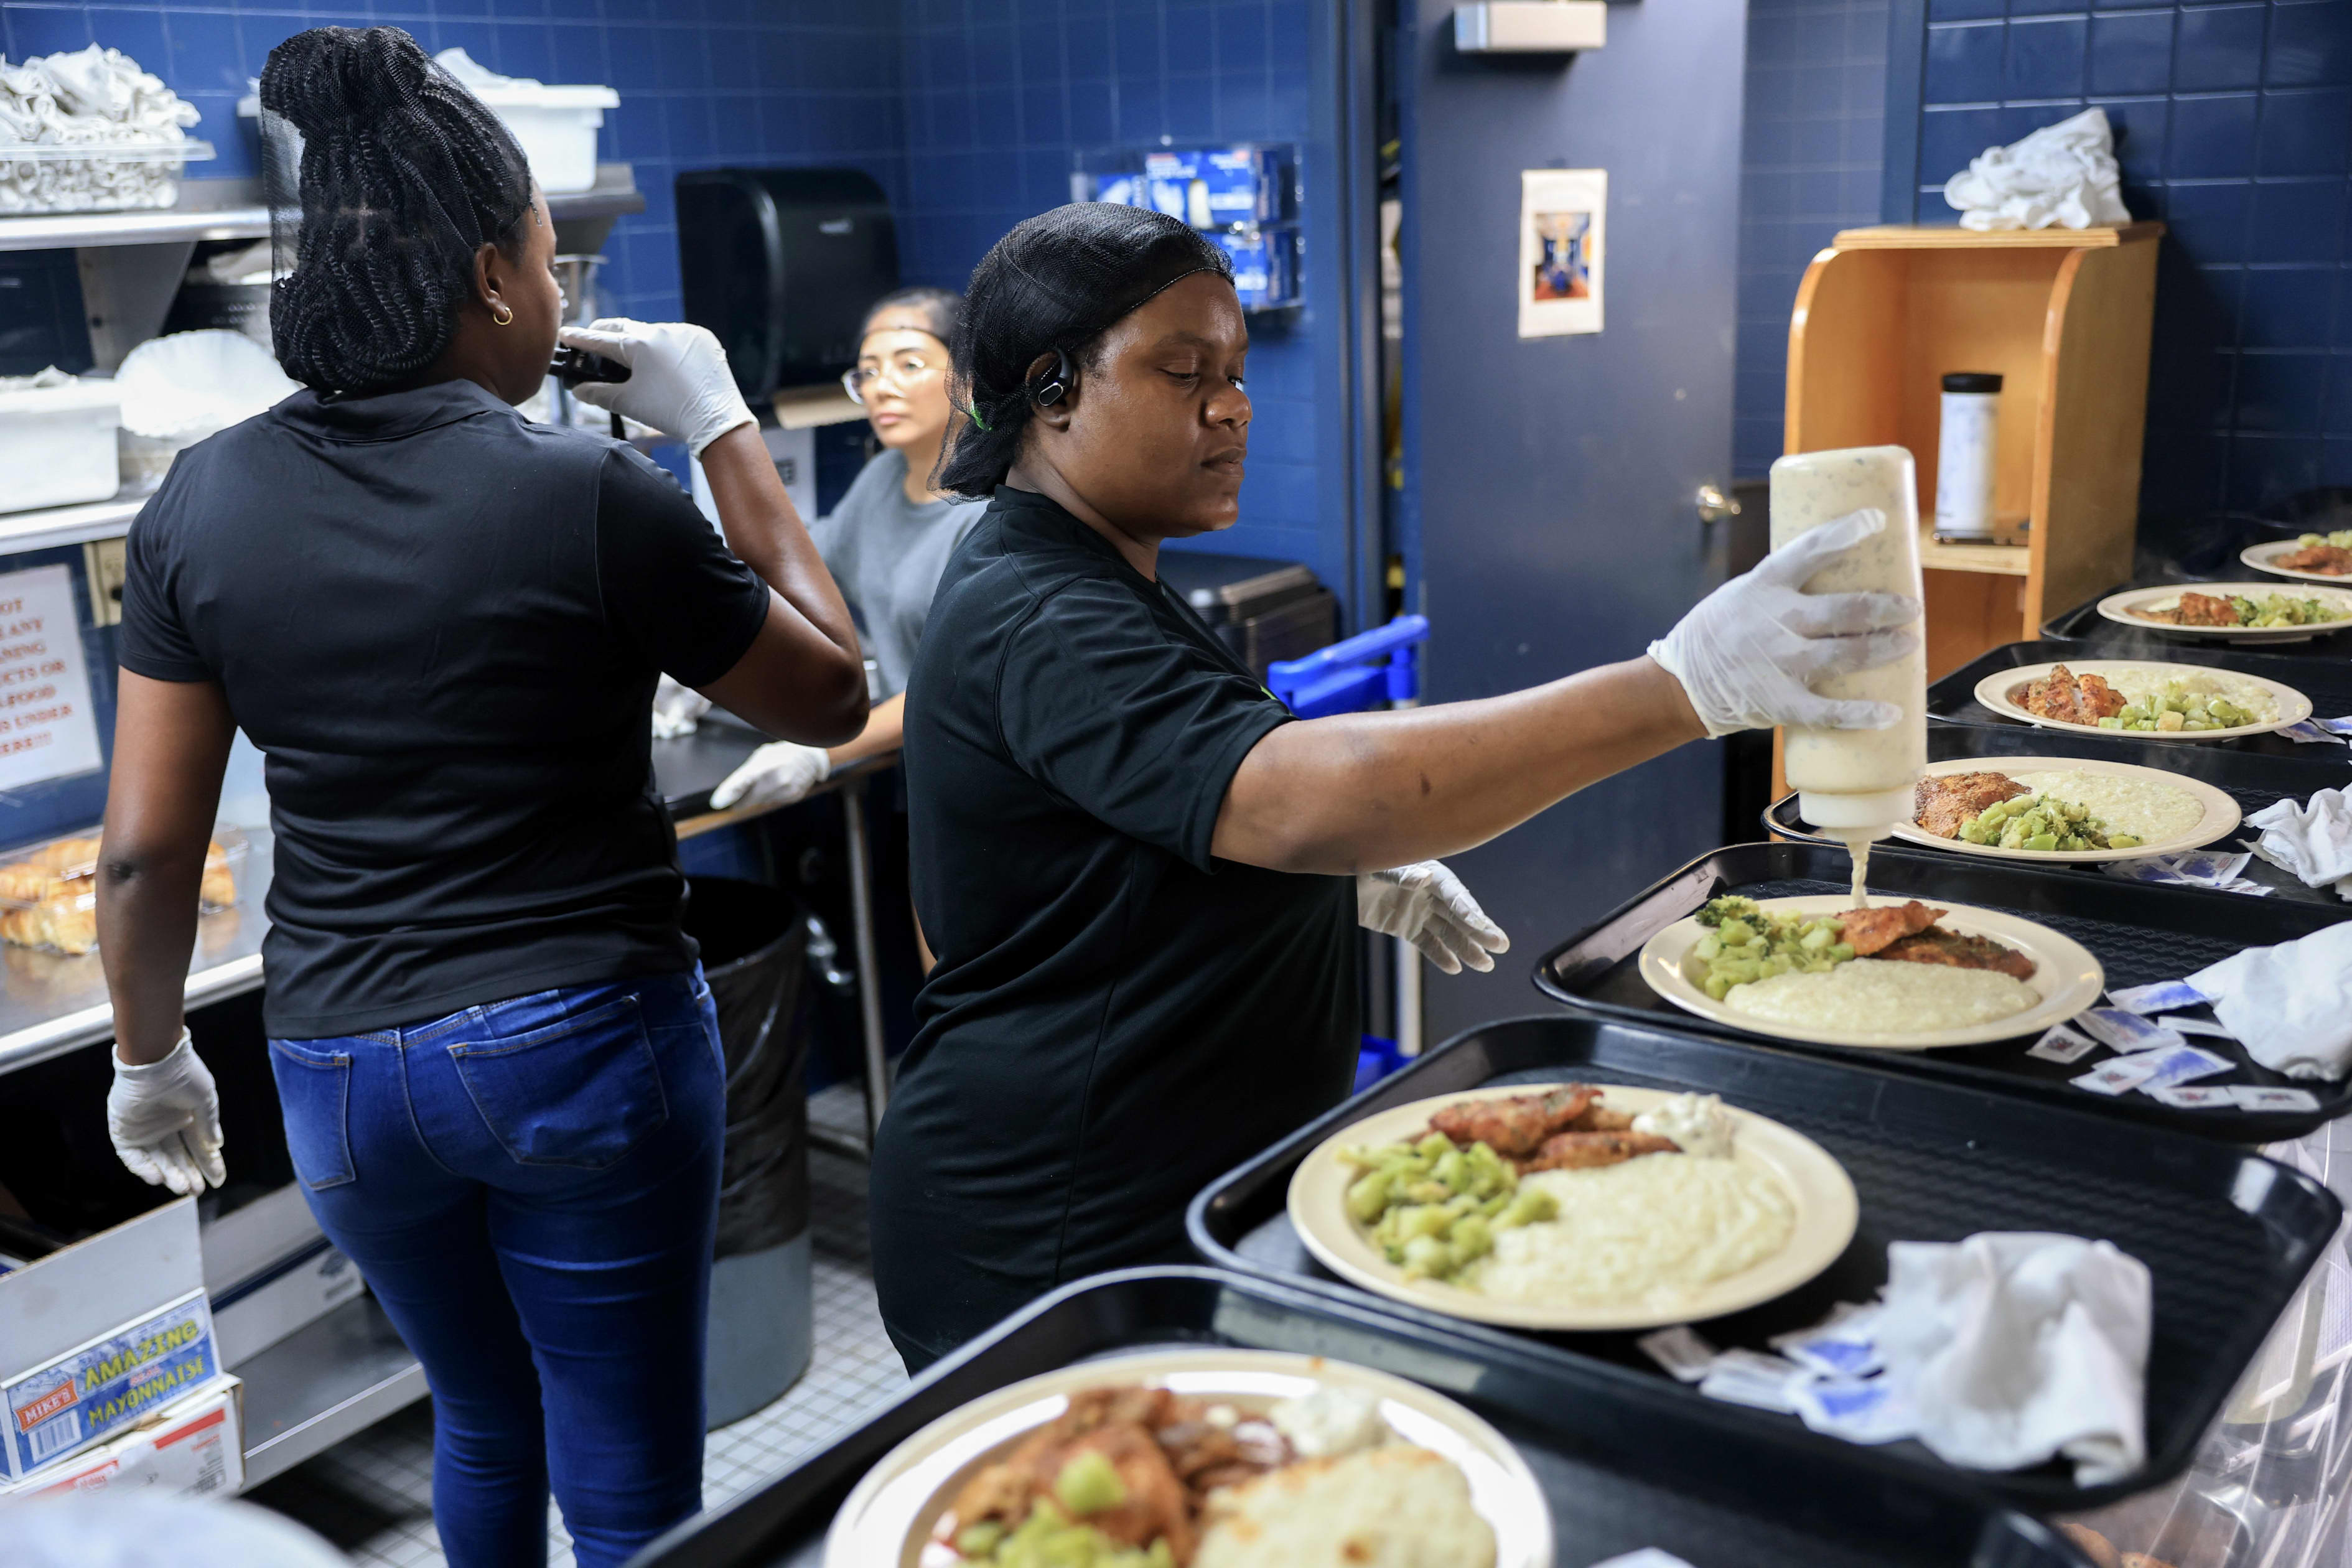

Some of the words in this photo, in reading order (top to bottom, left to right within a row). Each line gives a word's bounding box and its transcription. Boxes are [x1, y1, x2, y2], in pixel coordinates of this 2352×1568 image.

[85, 1318, 198, 1391] AMAZING
[24, 1387, 72, 1425] MIKE'S
[88, 1355, 205, 1429] MAYONNAISE
